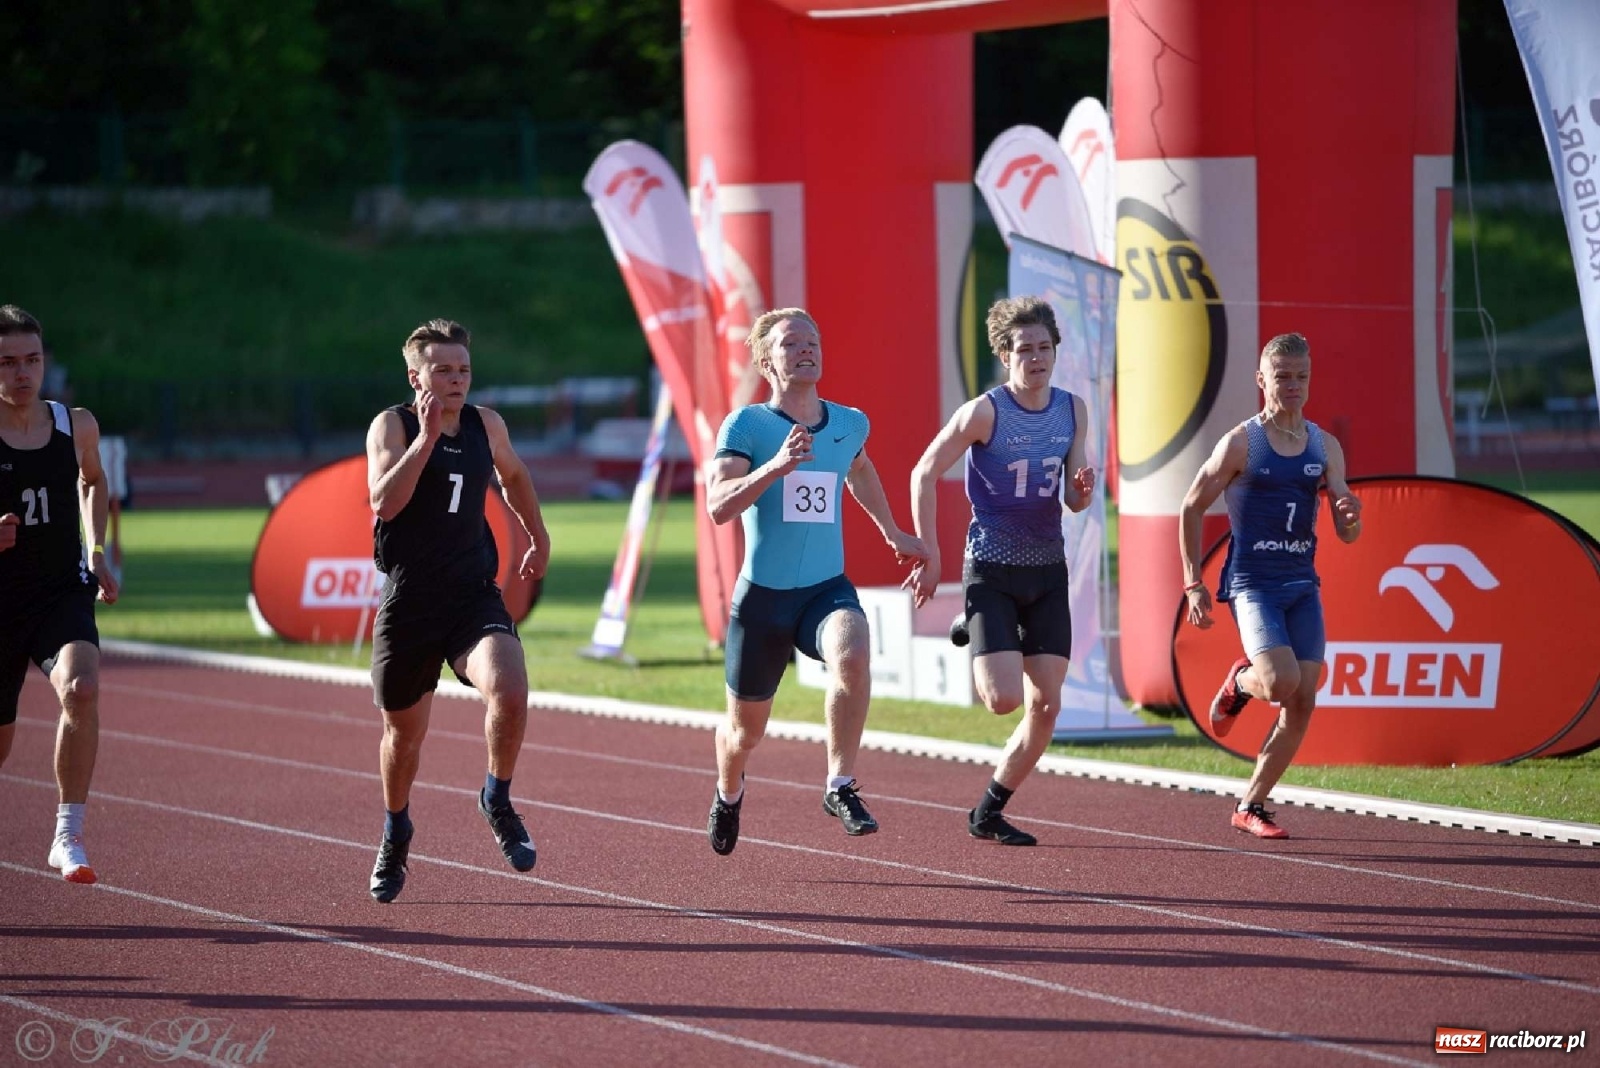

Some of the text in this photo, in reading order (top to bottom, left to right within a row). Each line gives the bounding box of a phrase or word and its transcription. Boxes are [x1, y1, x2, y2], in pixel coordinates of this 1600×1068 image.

[448, 473, 464, 514] 7
[1007, 456, 1062, 498] 13
[22, 487, 50, 526] 21
[795, 485, 827, 513] 33
[1286, 502, 1297, 532] 7
[1316, 652, 1485, 698] RLEN
